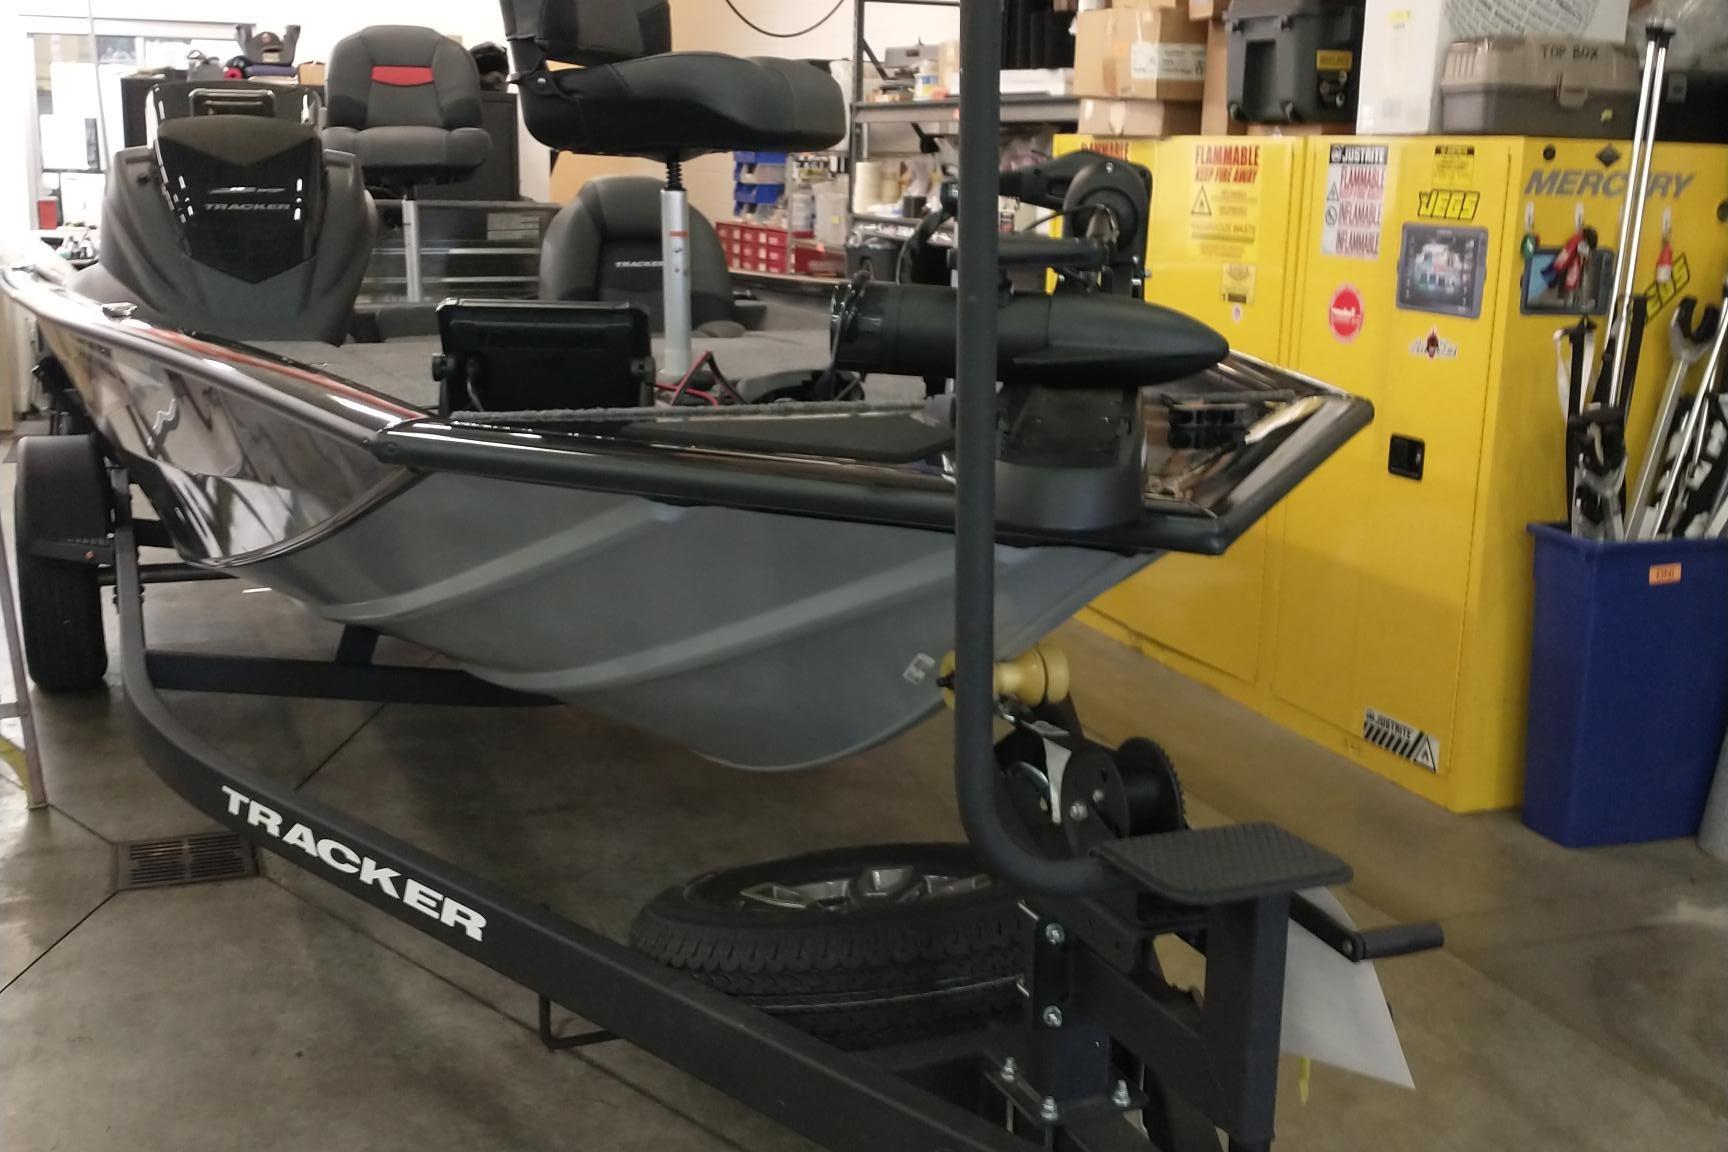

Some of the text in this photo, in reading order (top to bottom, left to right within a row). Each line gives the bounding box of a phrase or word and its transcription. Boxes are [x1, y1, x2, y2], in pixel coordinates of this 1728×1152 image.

[1541, 43, 1599, 61] TOP BOX
[1195, 144, 1259, 166] FLAMMABLE
[1342, 146, 1387, 164] JUSTRITE
[1194, 166, 1258, 185] KEEP FIRE AWAY
[1340, 165, 1384, 189] FLAMMABLE
[1524, 169, 1696, 198] MERCRY
[1417, 189, 1480, 221] JEGS
[1643, 252, 1691, 326] EGS
[221, 785, 487, 942] TRACKER
